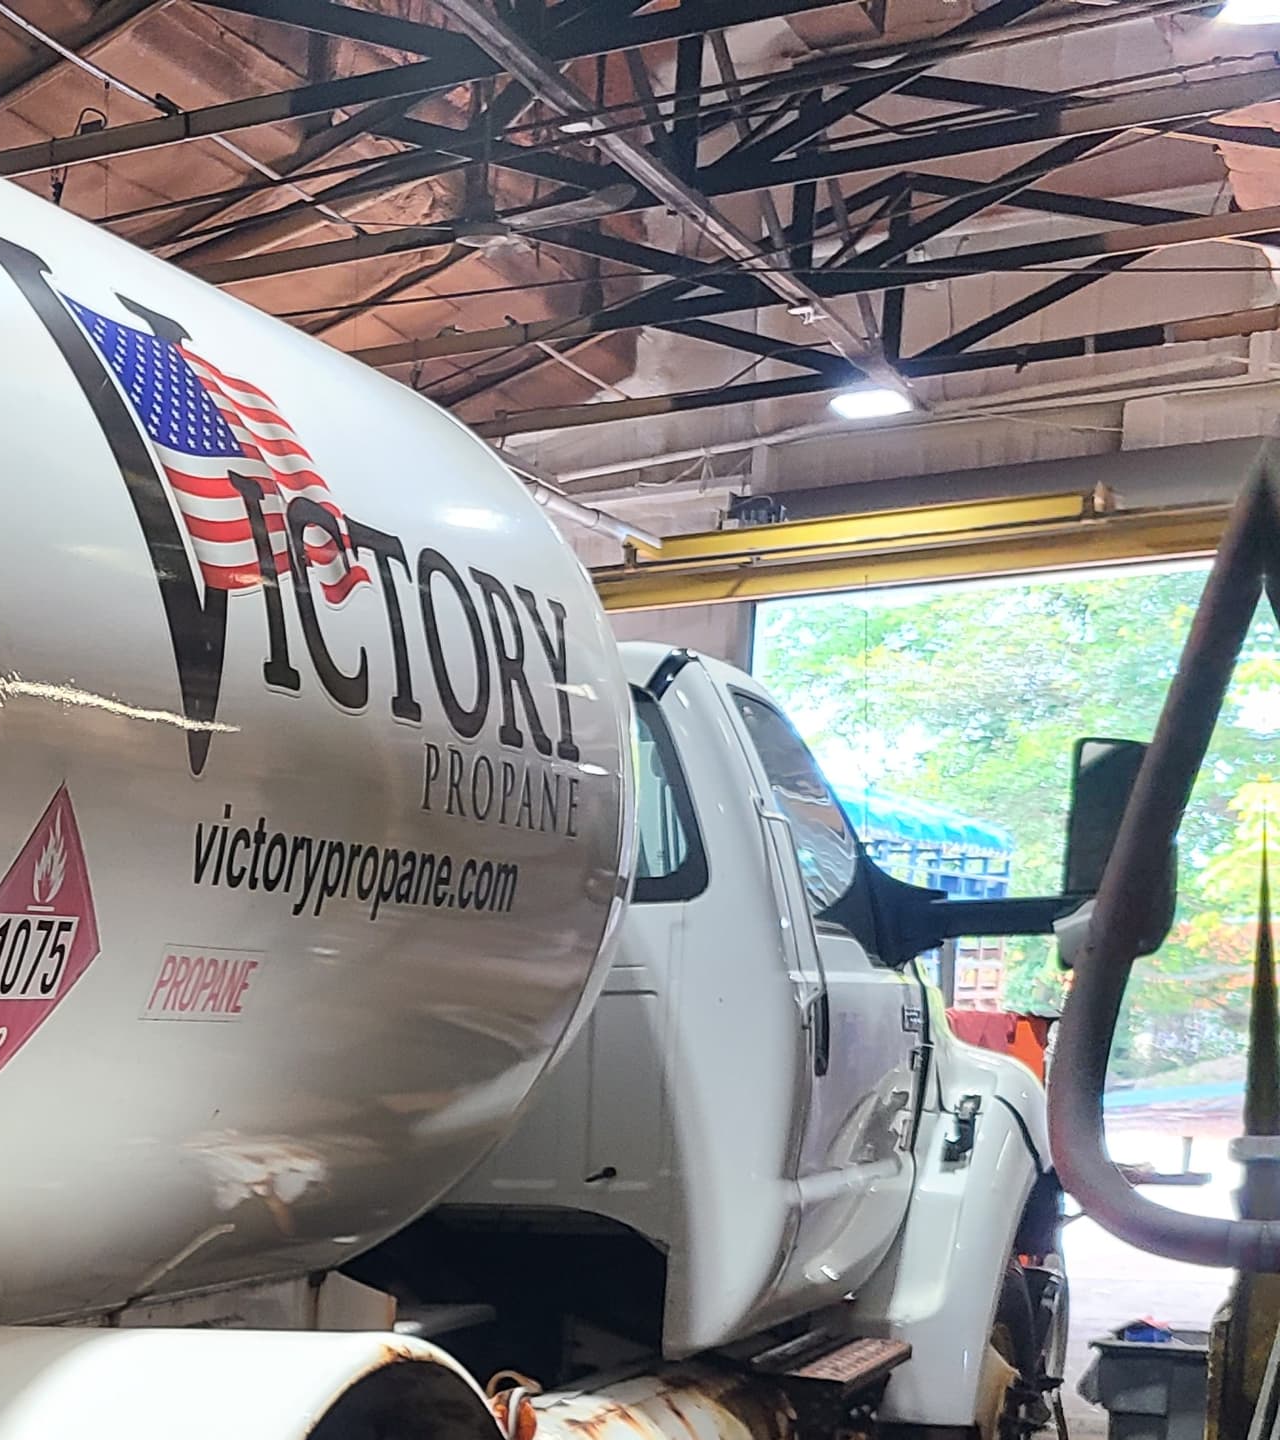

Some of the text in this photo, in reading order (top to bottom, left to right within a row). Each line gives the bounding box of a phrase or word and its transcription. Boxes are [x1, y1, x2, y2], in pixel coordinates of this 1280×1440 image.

[419, 743, 580, 837] PROPANE
[193, 804, 518, 920] victorypropane.com
[147, 955, 258, 1013] PROPANE
